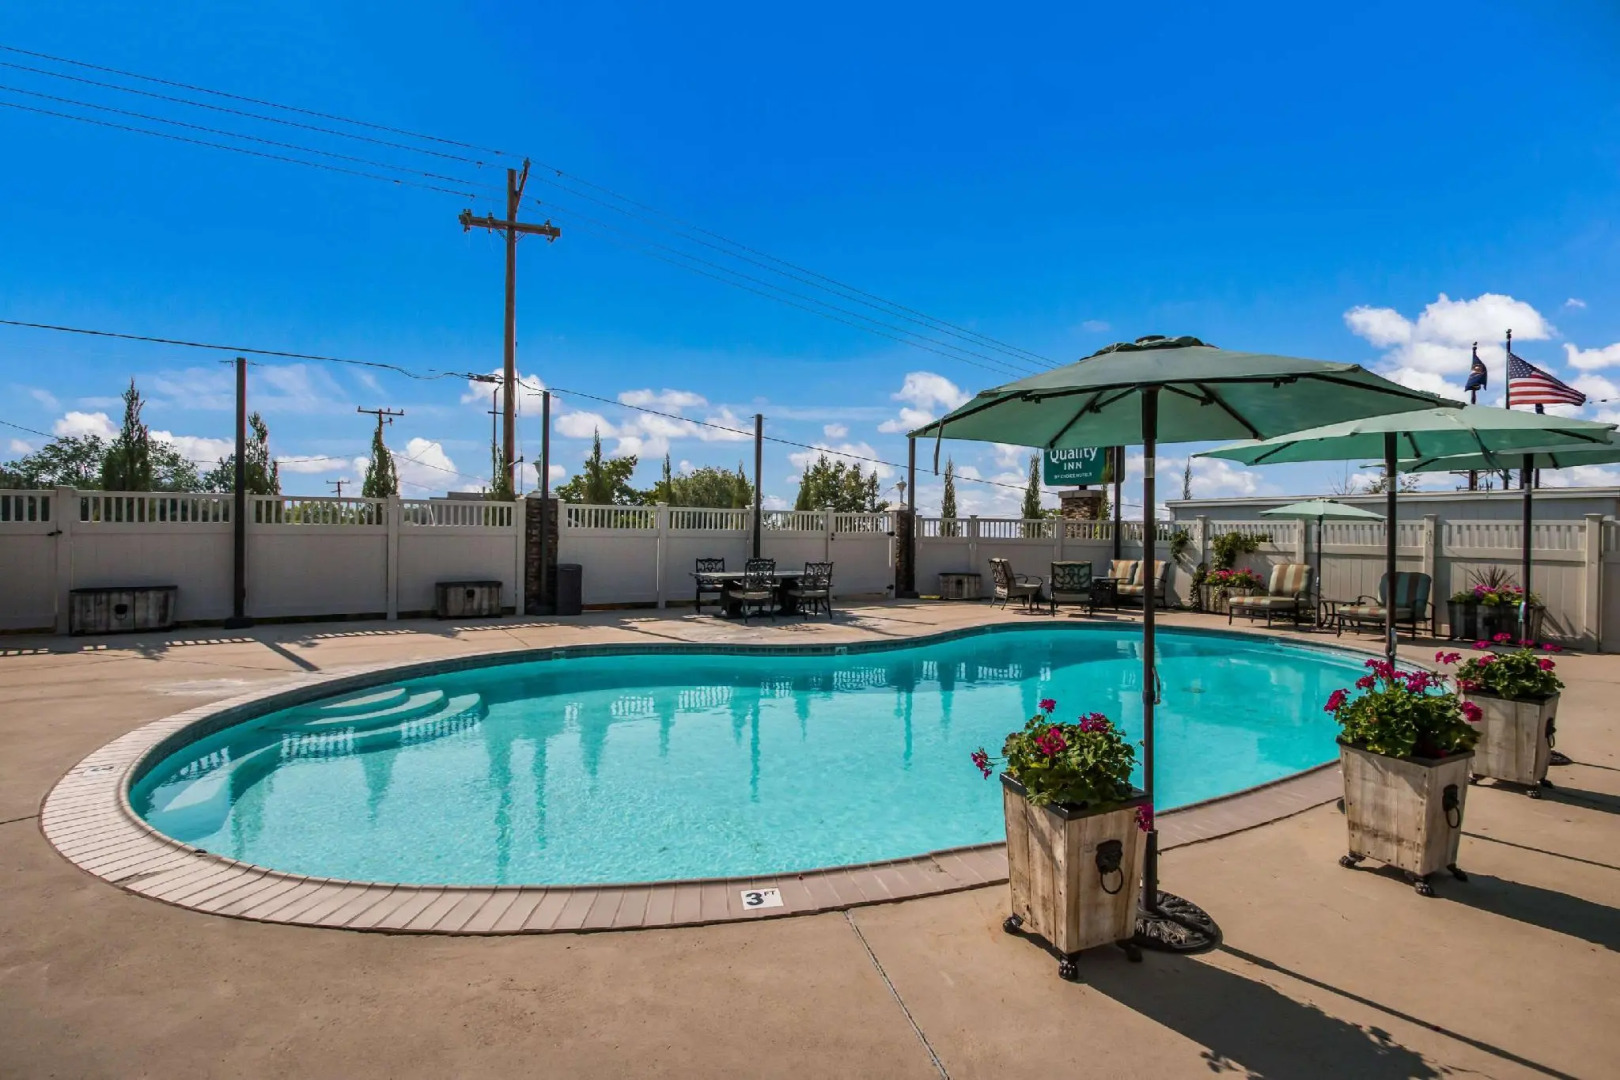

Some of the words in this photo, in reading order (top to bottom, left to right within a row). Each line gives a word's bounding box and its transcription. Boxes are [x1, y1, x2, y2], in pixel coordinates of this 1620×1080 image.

[1050, 447, 1098, 464] Quality
[1063, 462, 1082, 470] INN
[745, 892, 764, 906] 3
